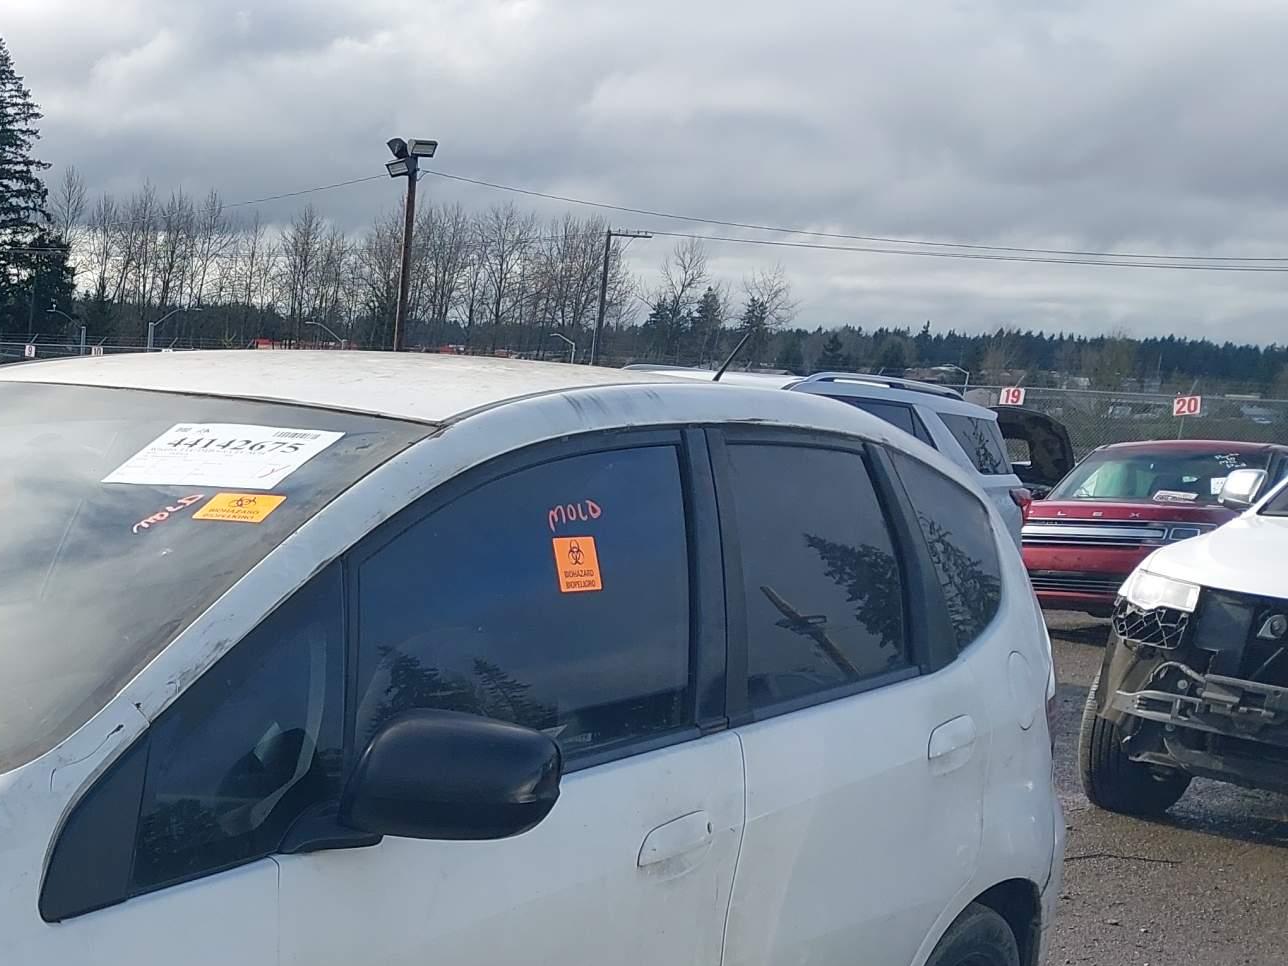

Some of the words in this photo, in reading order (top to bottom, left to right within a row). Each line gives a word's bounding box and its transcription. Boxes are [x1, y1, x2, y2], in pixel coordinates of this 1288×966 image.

[1003, 388, 1021, 404] 19
[1177, 398, 1198, 415] 20
[167, 436, 306, 454] 44142675
